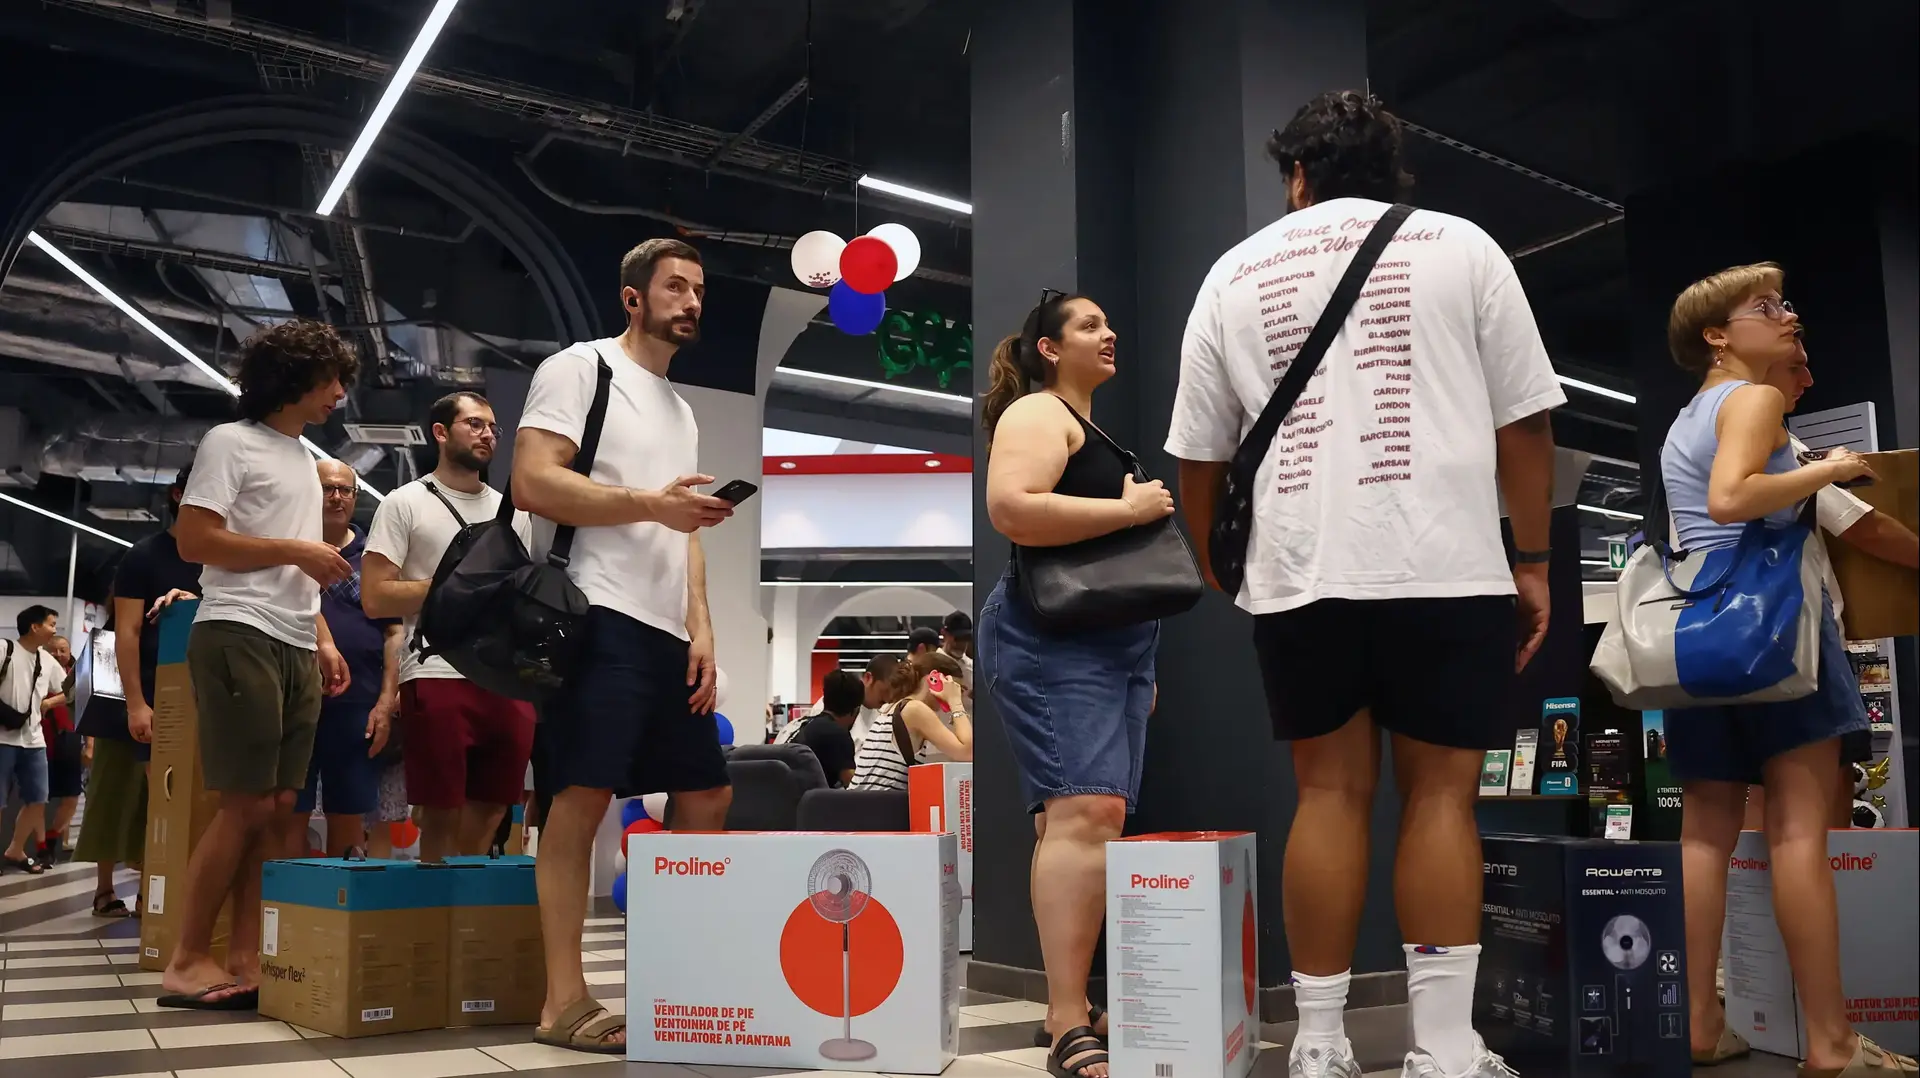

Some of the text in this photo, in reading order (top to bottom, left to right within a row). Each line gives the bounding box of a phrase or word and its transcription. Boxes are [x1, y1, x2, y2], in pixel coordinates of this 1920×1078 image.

[1282, 224, 1332, 242] Visit
[1230, 227, 1444, 286] Locations Worwide!
[1374, 261, 1411, 270] ORONTO
[1258, 271, 1315, 289] MINNEAPOLIS
[1369, 273, 1411, 284] HERSHEY
[1259, 286, 1298, 302] HOUSTON
[1360, 286, 1411, 298] ASHINGTON
[1261, 301, 1292, 315] DALLAS
[1369, 300, 1411, 311] COLOGNE
[1263, 314, 1299, 329] ATLANTA
[1360, 314, 1411, 328] FRANKFURT
[1368, 329, 1411, 339] GLASGOW
[1354, 344, 1411, 357] BIRMINGHAM
[1270, 359, 1289, 371] NEW
[1356, 358, 1411, 370] AMSTERDAM
[1386, 373, 1411, 381] PARIS
[1373, 387, 1411, 396] CARDIFF
[1293, 396, 1325, 410] ANGELE
[1375, 402, 1411, 411] LONDON
[1378, 416, 1411, 424] LISBON
[1360, 430, 1411, 443] BARCELONA
[1280, 445, 1295, 453] LAS
[1384, 445, 1411, 453] ROME
[1279, 459, 1291, 467] ST.
[1371, 459, 1411, 469] WARSAW
[1278, 469, 1312, 481] CHICAGO
[1358, 472, 1411, 486] STOCKHOLM
[1277, 482, 1309, 494] DETROIT
[1546, 702, 1576, 710] Hisense
[1551, 760, 1568, 768] FIFA
[1657, 797, 1682, 808] 100%
[1829, 852, 1873, 871] oline
[1484, 863, 1517, 876] enta
[1585, 868, 1662, 877] Rowenta
[1635, 888, 1667, 896] MOSQUITO
[261, 961, 288, 982] whisper
[1902, 996, 1918, 1008] PIE
[654, 1004, 755, 1019] VENTILADOR DE PIE
[654, 1017, 746, 1032] VENTOINHA DE PÉ
[654, 1030, 791, 1047] VENTILATORE A PIANTANA
